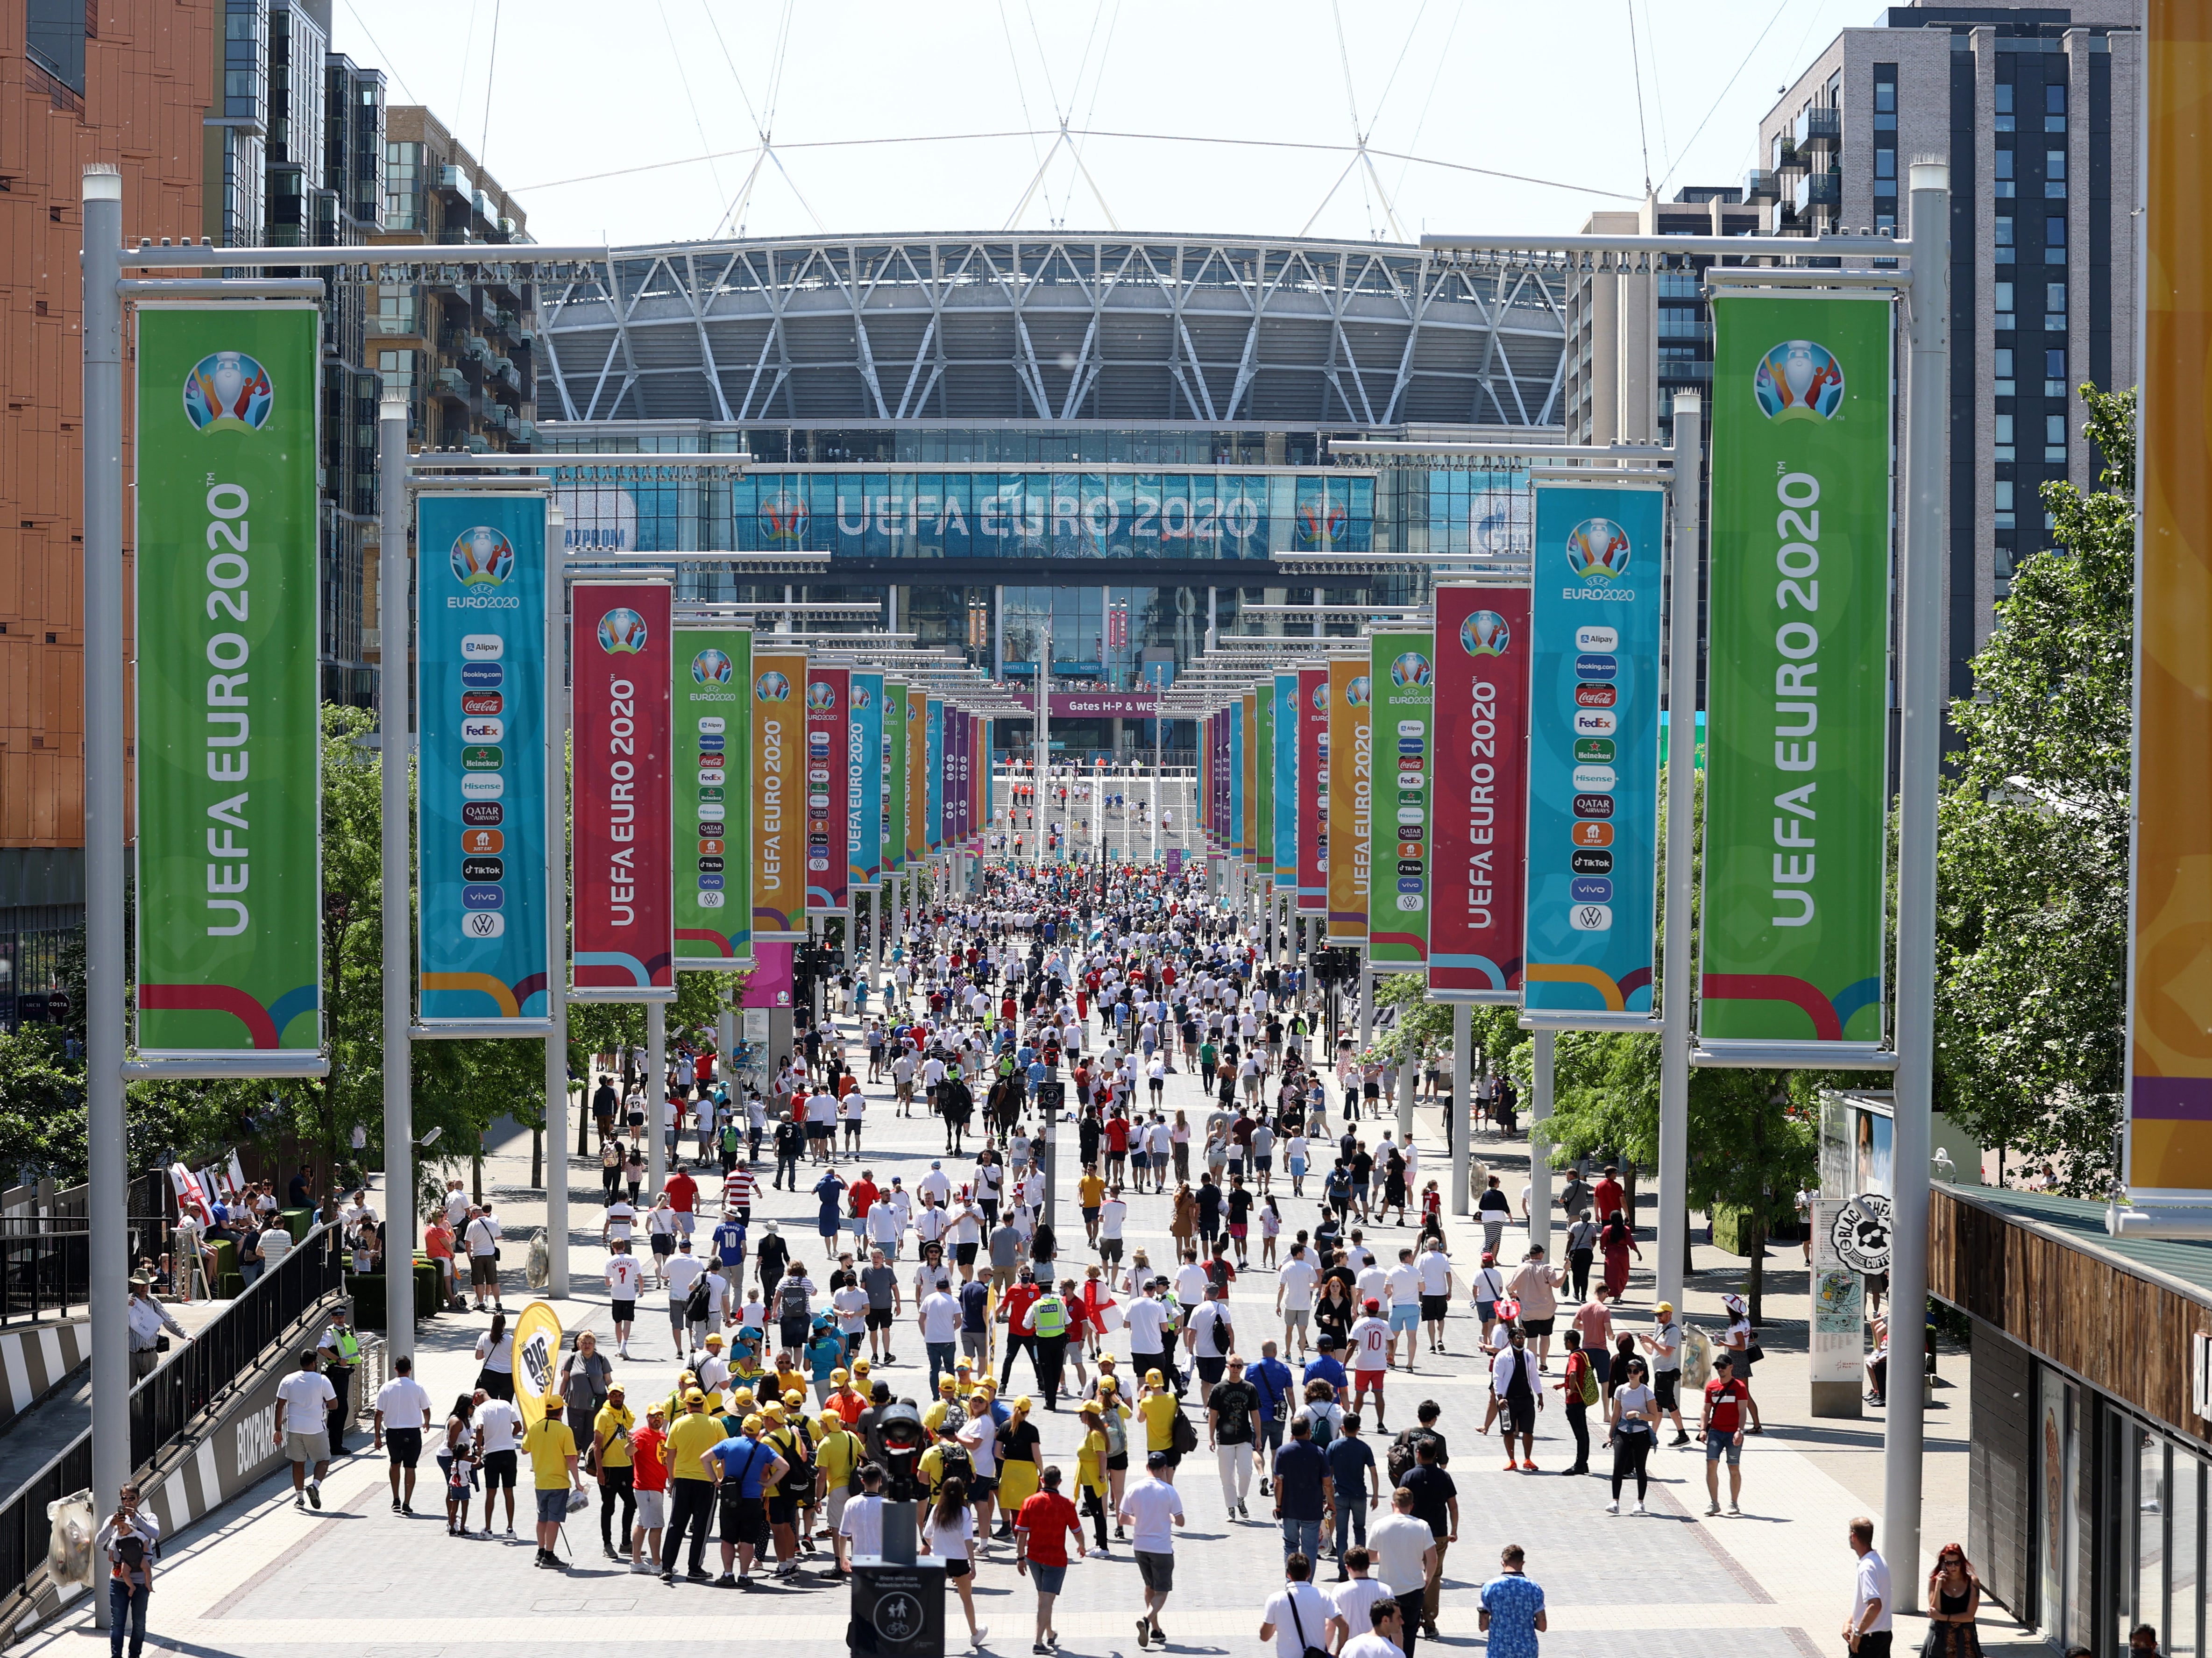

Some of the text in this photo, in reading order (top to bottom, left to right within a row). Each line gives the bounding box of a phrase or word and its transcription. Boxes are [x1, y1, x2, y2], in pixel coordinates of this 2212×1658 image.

[838, 496, 1258, 537] UEFA EURO 2020
[565, 530, 624, 547] AZPROM
[471, 586, 493, 595] UEFA
[1586, 578, 1609, 587] UEFA
[447, 596, 519, 608] EURO2020
[1562, 588, 1634, 601] EURO2020
[1070, 701, 1158, 711] Gates H-P & WES
[1772, 472, 1820, 926] UEFA EURO 2020
[206, 484, 249, 935] UEFA EURO 2020
[466, 725, 498, 736] FedEx
[1579, 717, 1610, 728] FedEx
[848, 723, 863, 851] UEFA EURO 2020
[466, 807, 499, 815] QATAR
[610, 680, 635, 926] UEFA EURO 2020
[764, 721, 781, 889] UEFA EURO 2020
[1354, 725, 1370, 894] UEFA EURO 2020
[1468, 682, 1496, 928] UEFA EURO 2020
[1577, 799, 1609, 808] QATAR
[785, 1129, 793, 1138] 3
[1838, 1210, 1862, 1238] BLAC
[723, 1232, 737, 1248] 10
[618, 1267, 626, 1283] 7
[518, 1341, 527, 1351] THE
[1368, 1331, 1381, 1351] 10
[522, 1337, 549, 1379] BIG
